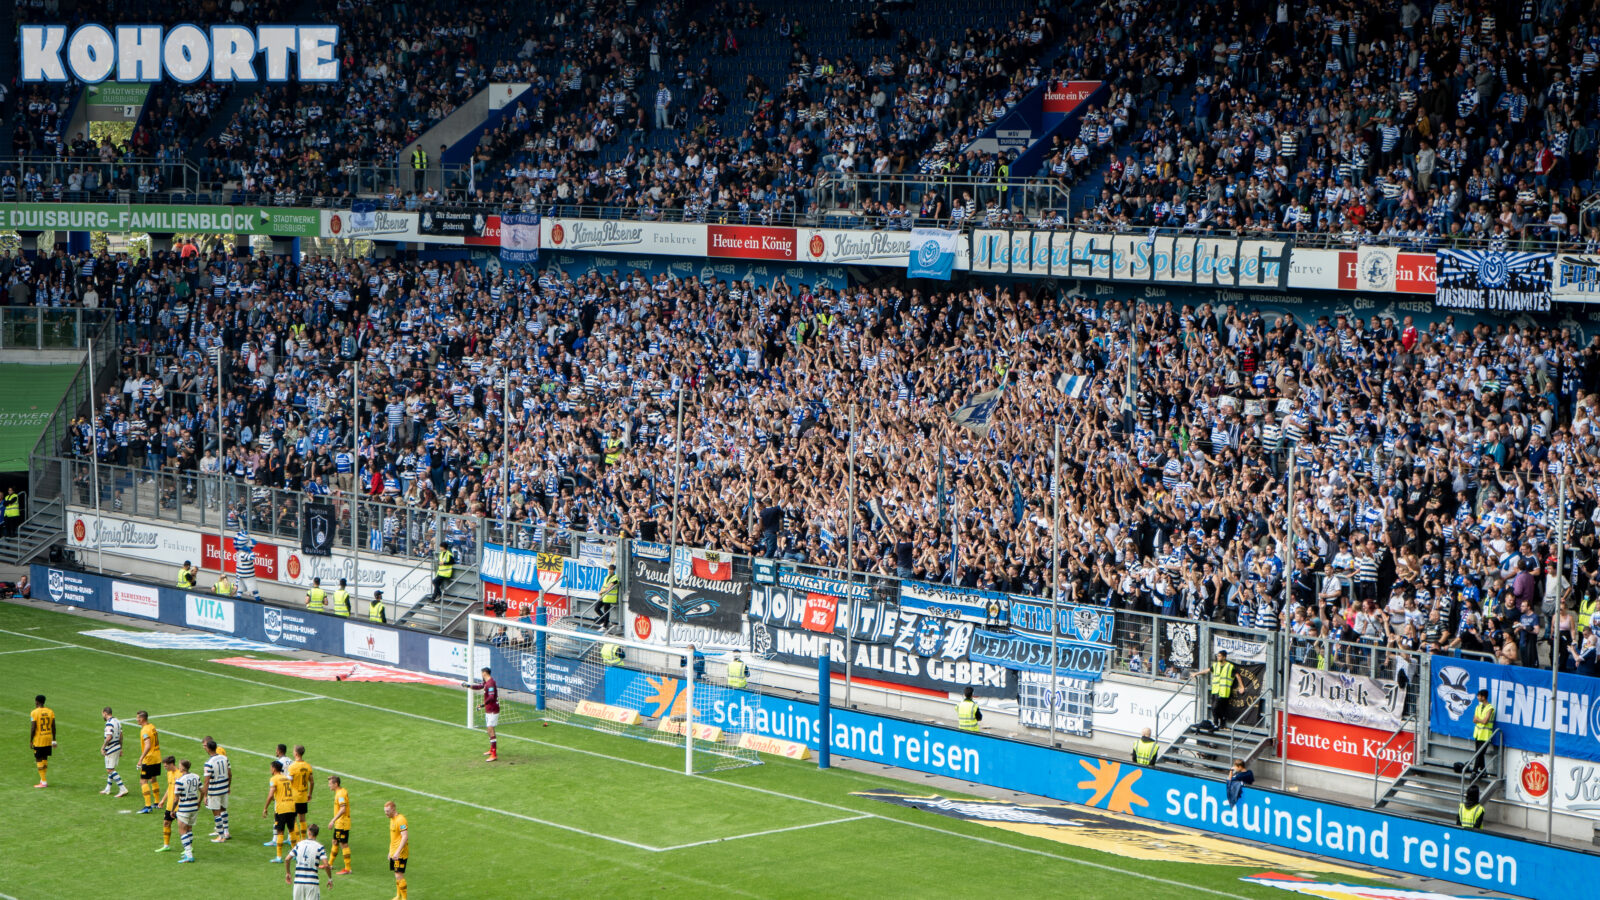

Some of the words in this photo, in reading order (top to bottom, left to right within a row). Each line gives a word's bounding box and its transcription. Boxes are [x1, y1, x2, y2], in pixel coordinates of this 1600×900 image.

[1066, 91, 1077, 100] ein
[127, 107, 132, 115] 7
[10, 210, 254, 230] DUISBURG-FAMILIENBLOCK
[273, 215, 316, 224] STADTWERKE
[273, 224, 306, 233] DUISBURG
[653, 232, 697, 245] Fankurve
[713, 233, 742, 249] Heute
[744, 239, 759, 250] ein
[761, 237, 792, 256] König
[870, 231, 911, 255] Pilsene
[1435, 287, 1485, 309] DUISBURG
[1488, 289, 1552, 312] DYNAMITES
[163, 539, 198, 553] Fankurve
[206, 544, 231, 561] Hete
[560, 560, 609, 592] DUISBUR
[635, 560, 670, 584] Proud
[64, 593, 85, 603] PARTNER
[808, 598, 835, 612] ULTRAS
[195, 598, 225, 621] VITA
[750, 587, 899, 637] KOHRTE
[1098, 614, 1115, 643] 47
[282, 634, 306, 643] PARTNER
[971, 632, 1105, 673] WEDAUSTADION
[854, 644, 920, 677] ALLES
[926, 660, 1007, 688] GEBEN!
[1298, 669, 1369, 706] Block
[582, 703, 615, 720] Sinalco
[40, 717, 51, 732] 22
[714, 696, 884, 756] schauinsland
[893, 730, 980, 775] reisen
[745, 736, 781, 754] Sinalco
[1287, 726, 1329, 751] Heute
[1333, 736, 1358, 754] ein
[1362, 739, 1412, 769] König
[216, 760, 225, 776] 11
[186, 777, 198, 793] 29
[283, 782, 293, 797] 15
[1166, 784, 1389, 860] schauinsland
[1403, 832, 1518, 886] reisen
[302, 846, 308, 861] 4
